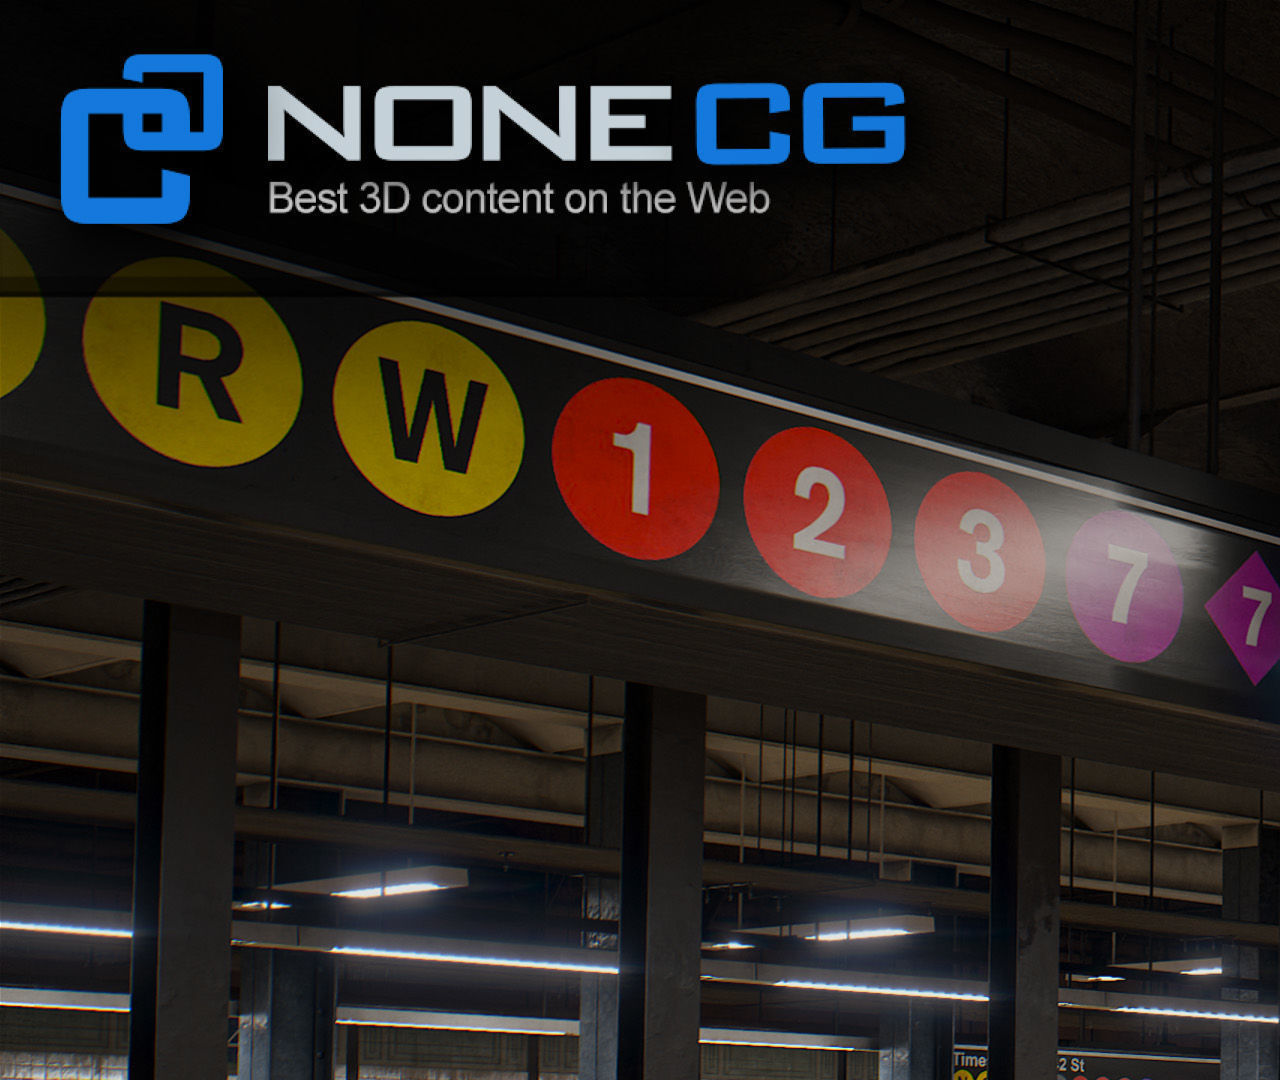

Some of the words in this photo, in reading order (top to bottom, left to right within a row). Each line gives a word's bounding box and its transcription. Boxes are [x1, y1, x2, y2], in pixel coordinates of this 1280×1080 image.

[156, 300, 244, 425] R
[377, 355, 489, 475] W
[612, 421, 652, 517] 1
[792, 465, 847, 560] 2
[956, 508, 1006, 594] 3
[1106, 543, 1149, 625] 7
[1241, 585, 1273, 647] 7
[953, 1052, 987, 1068] Time
[1070, 1057, 1085, 1073] St
